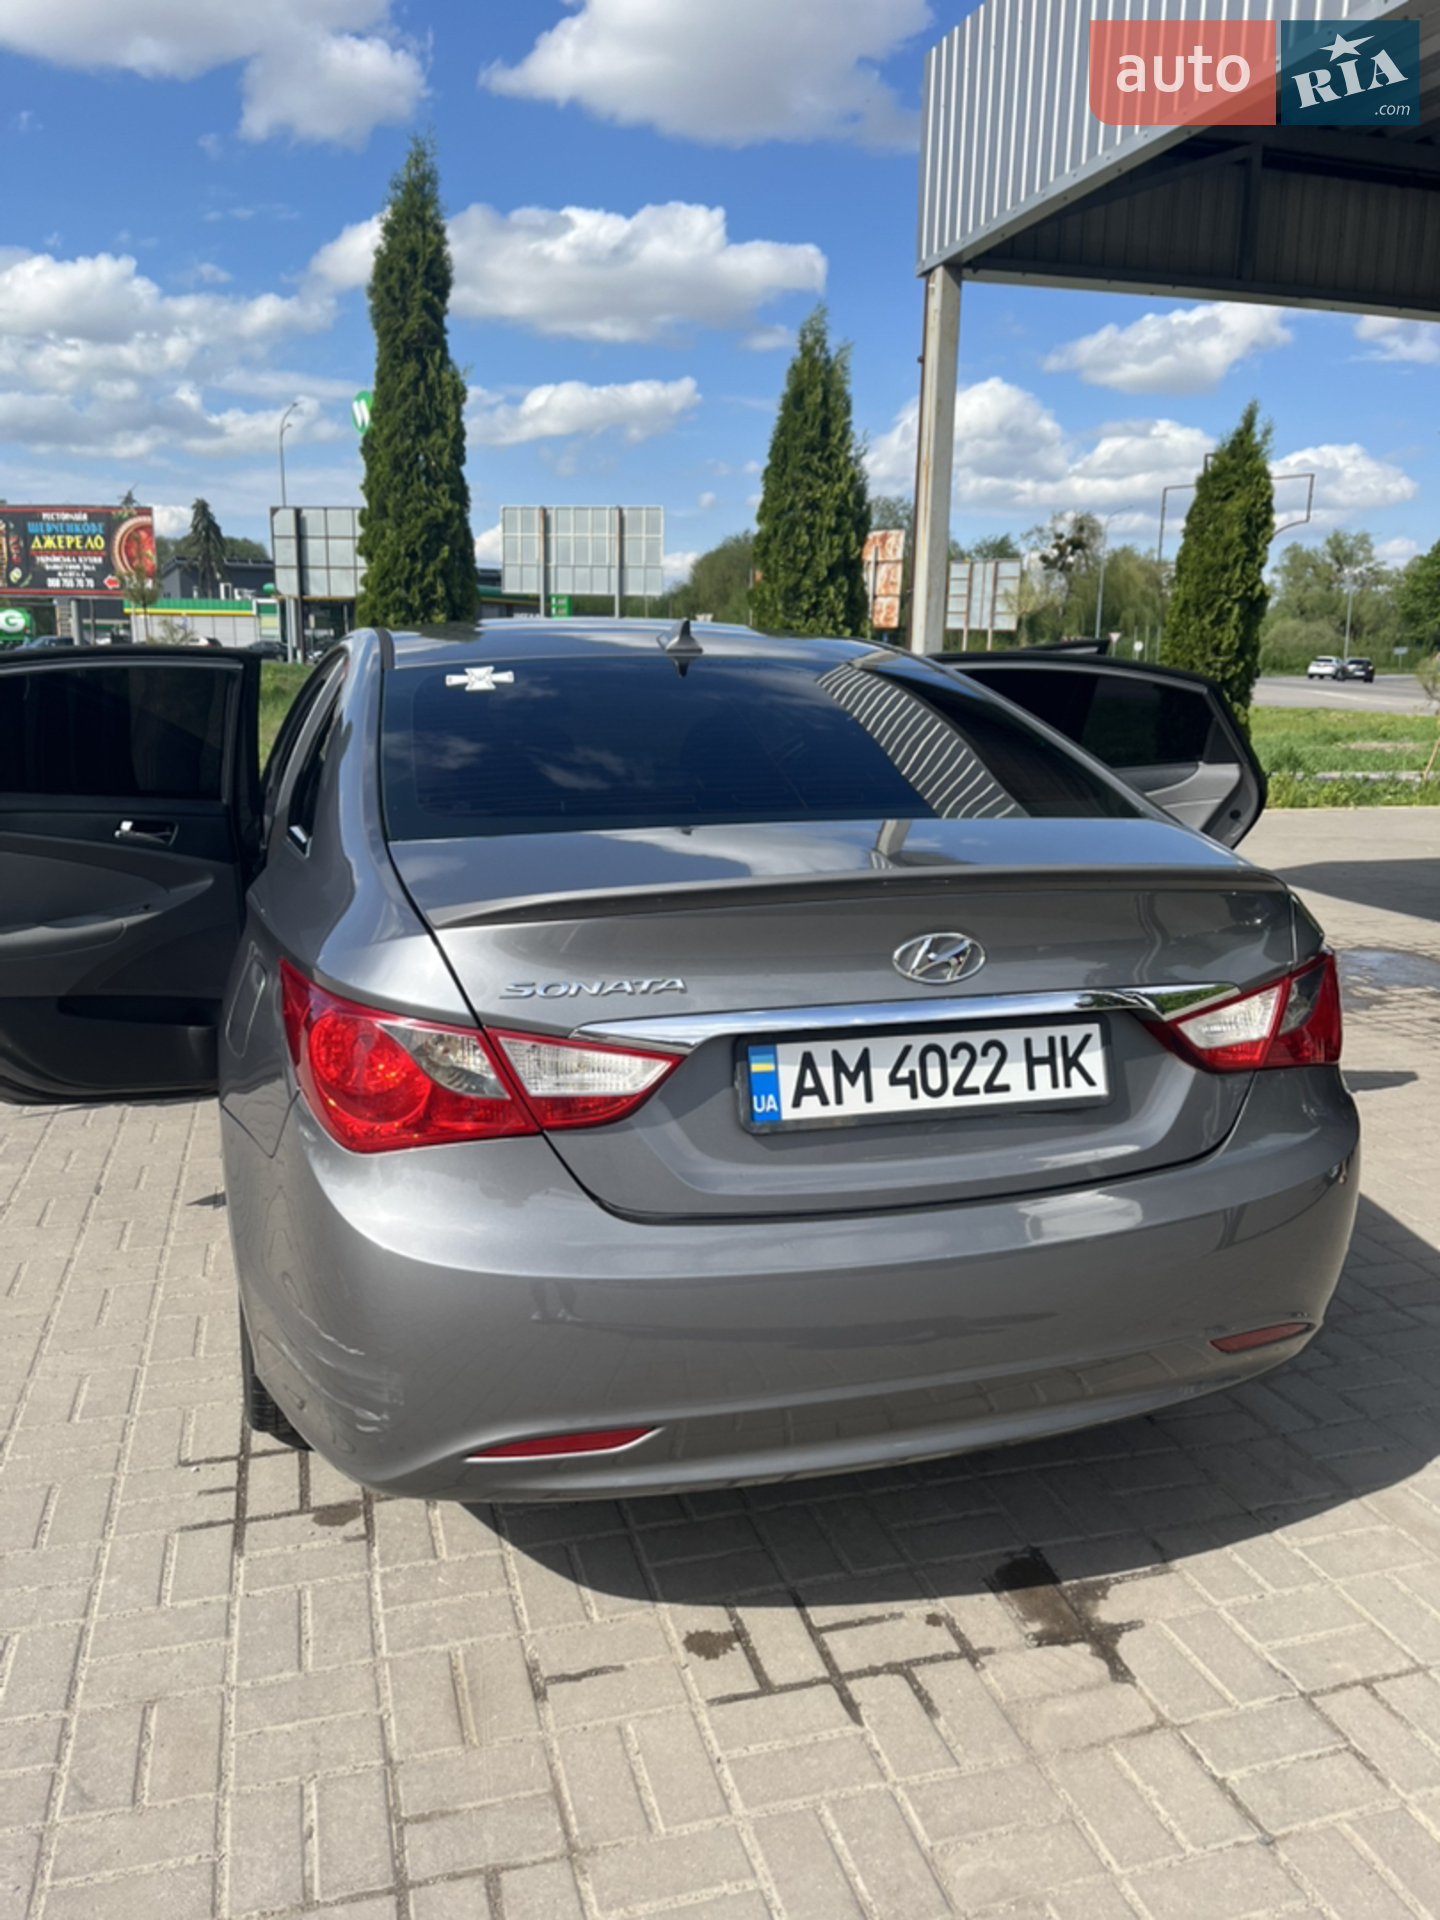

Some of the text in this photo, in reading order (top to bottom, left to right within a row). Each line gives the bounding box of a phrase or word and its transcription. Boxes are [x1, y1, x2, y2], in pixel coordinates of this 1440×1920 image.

[28, 522, 104, 534] ШЕВЧЕНКОВЕ
[31, 535, 105, 550] ДЖЕРЕЛО
[505, 978, 688, 999] SONATA
[792, 1033, 1098, 1108] AM 4022 HK
[752, 1094, 779, 1114] UA
